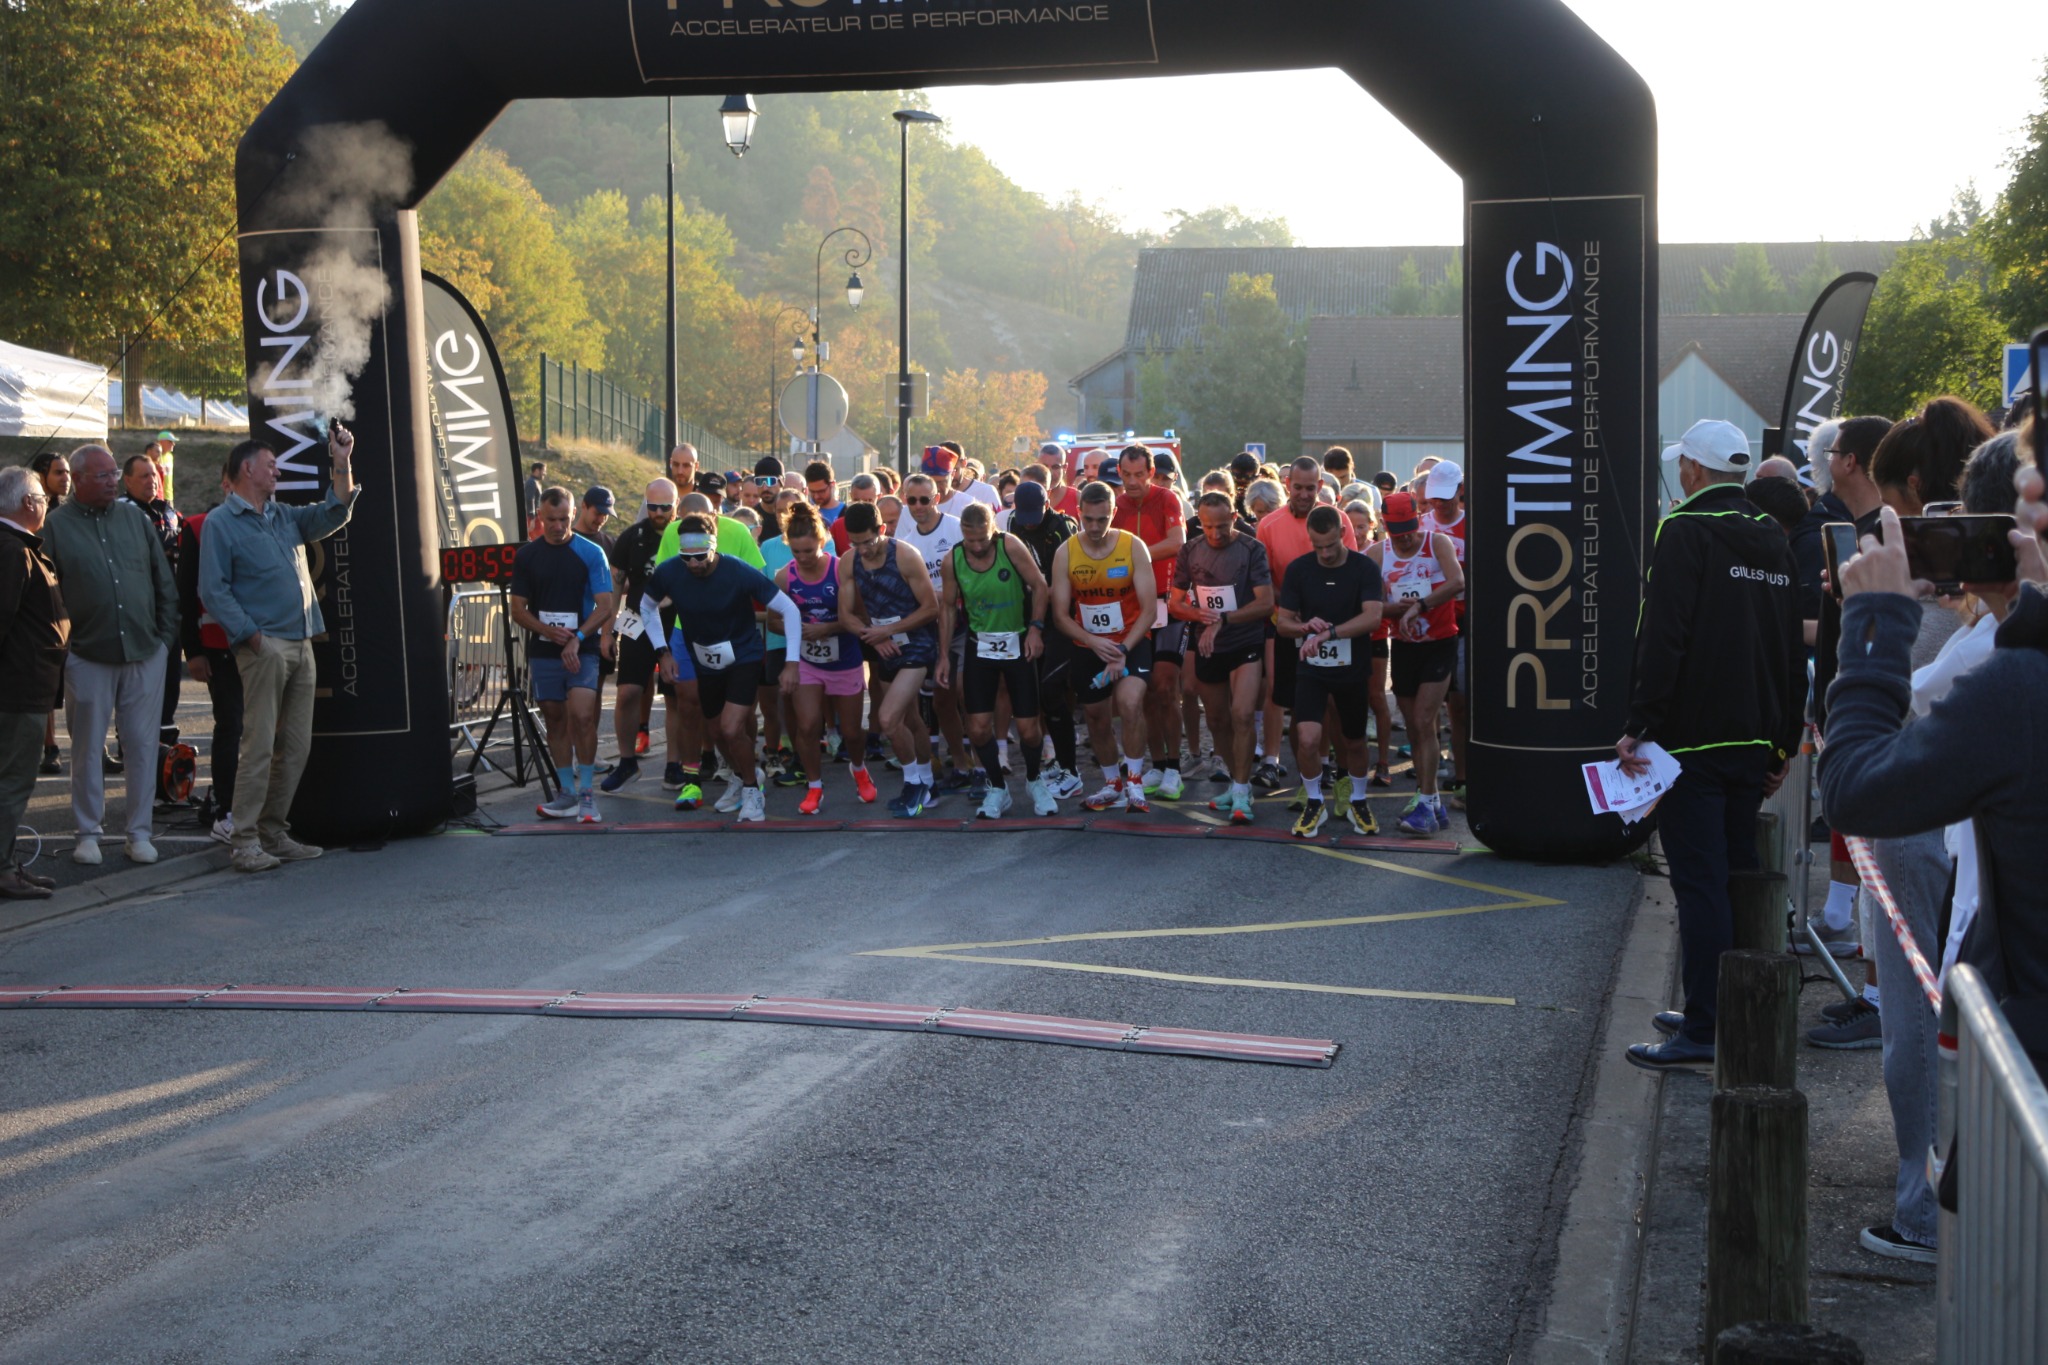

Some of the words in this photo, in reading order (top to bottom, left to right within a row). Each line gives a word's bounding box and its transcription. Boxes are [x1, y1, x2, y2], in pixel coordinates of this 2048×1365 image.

[670, 15, 862, 36] ACCELERATEUR
[870, 13, 904, 30] DE
[912, 5, 1110, 28] PERFORMANCE
[1583, 240, 1600, 449] PERFORMANCE
[1505, 241, 1574, 710] PROTIMING
[1583, 458, 1599, 493] DE
[1206, 596, 1225, 609] 89
[1582, 503, 1599, 709] ACCELERATEUR
[622, 617, 638, 630] 17
[1091, 613, 1111, 627] 49
[806, 642, 832, 658] 223
[989, 640, 1008, 653] 32
[1319, 645, 1339, 660] 64
[704, 652, 722, 665] 27
